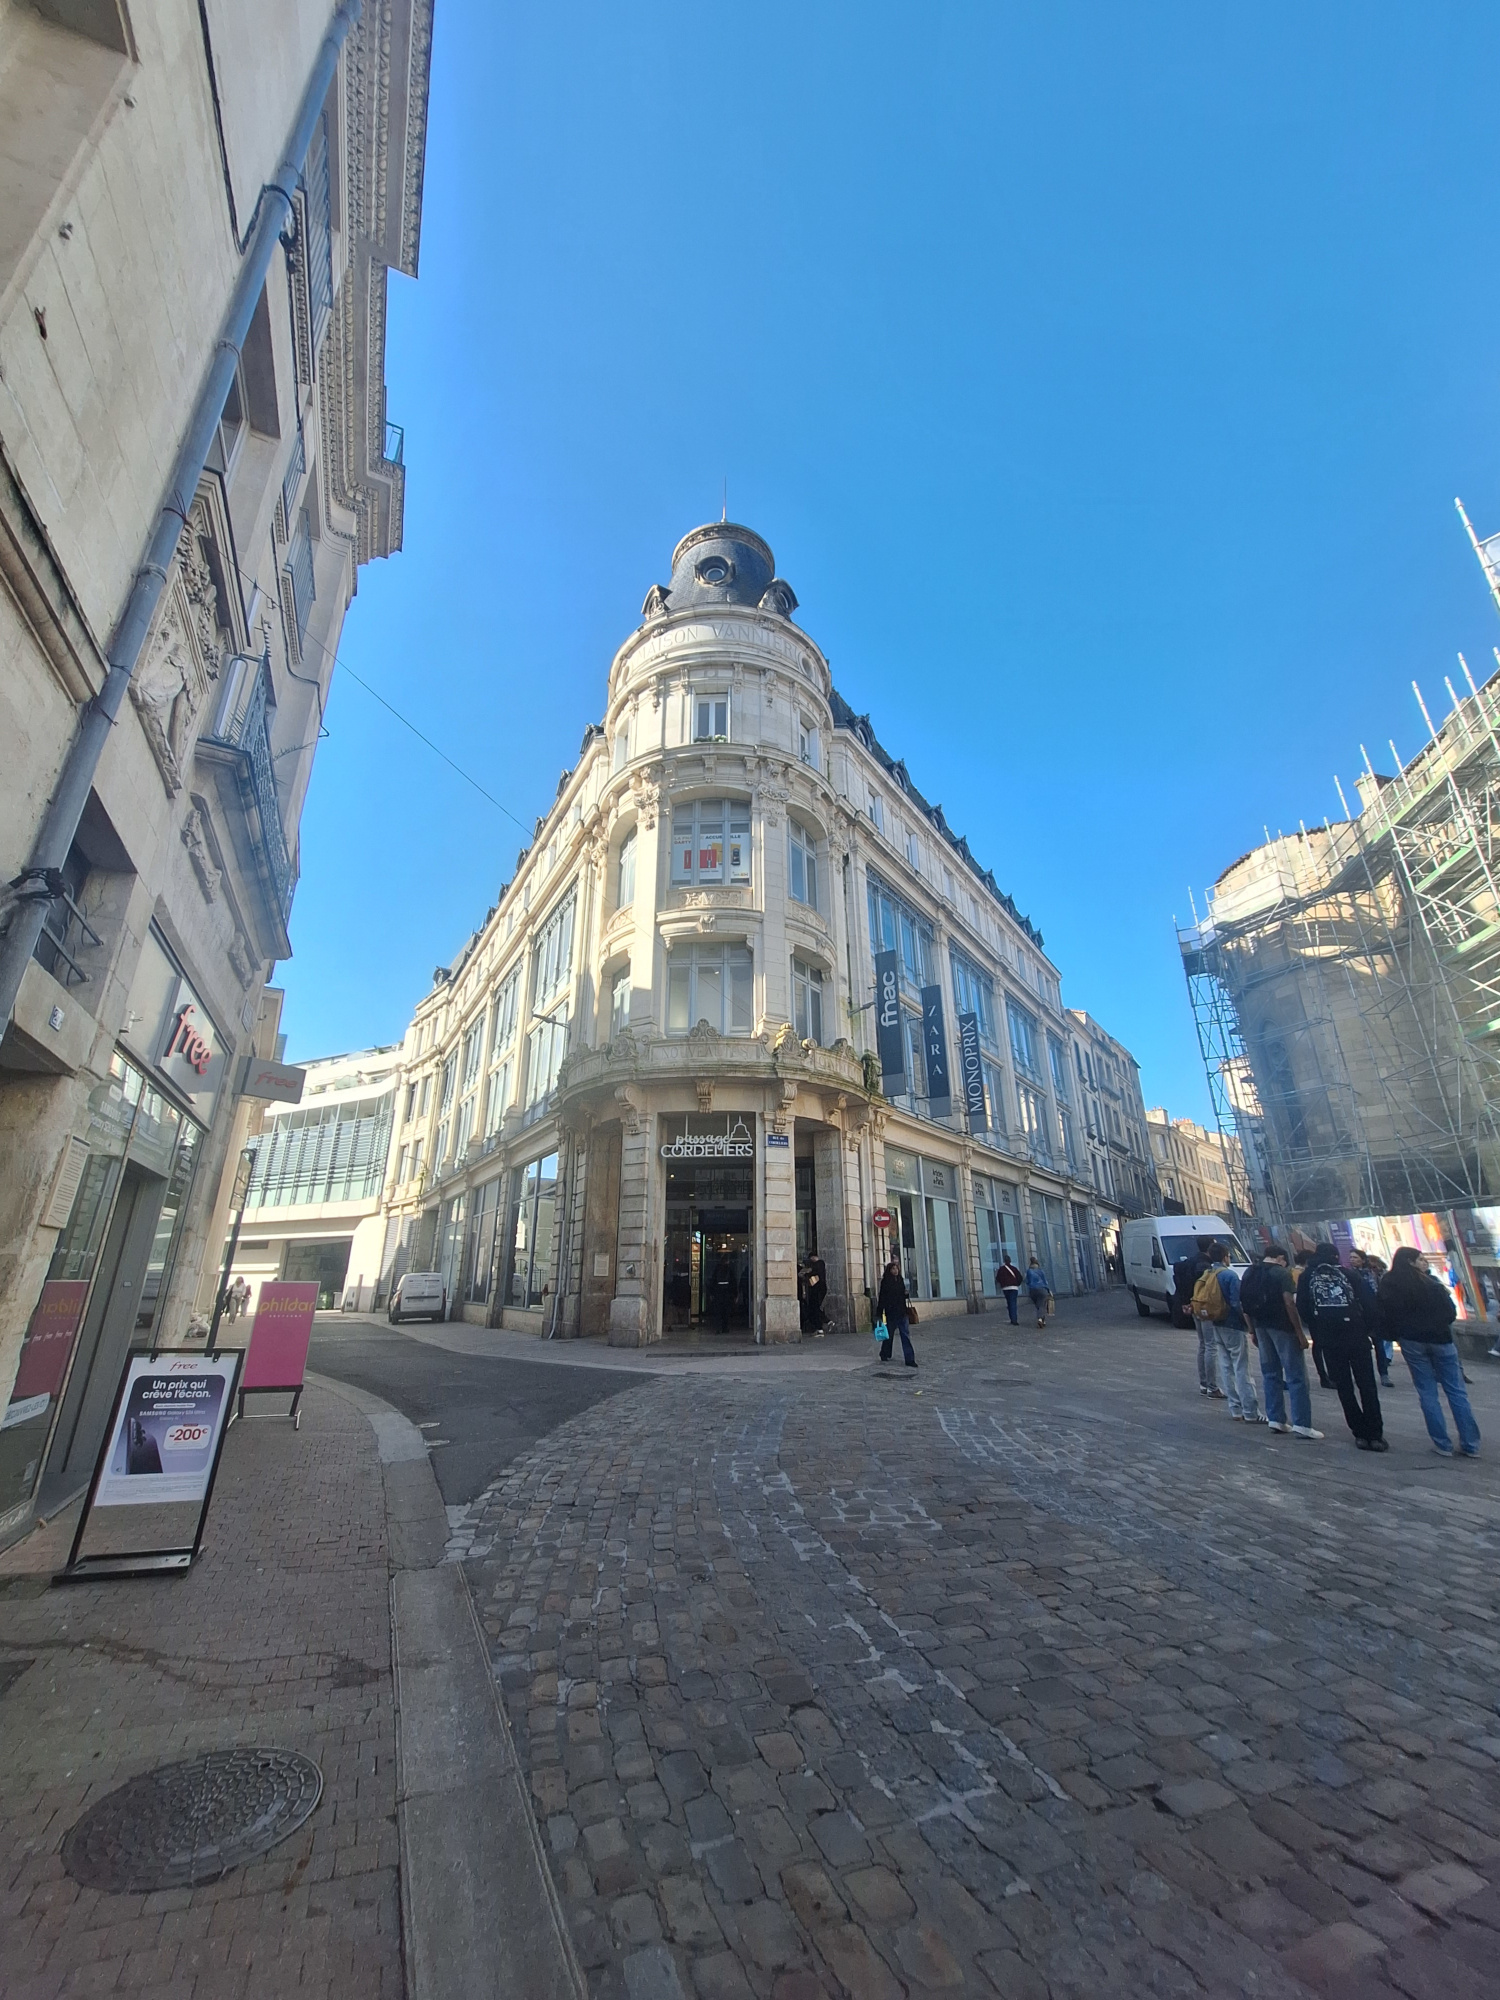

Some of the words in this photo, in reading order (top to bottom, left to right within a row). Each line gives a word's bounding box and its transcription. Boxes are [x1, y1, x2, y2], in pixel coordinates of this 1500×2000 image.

[636, 626, 698, 664] MAISON
[710, 623, 793, 658] VANNIER
[881, 970, 898, 1028] fnac
[165, 1004, 212, 1075] free
[928, 1005, 943, 1075] ZARA
[961, 1019, 984, 1113] MONOPRIX
[255, 1071, 299, 1088] free
[660, 1143, 753, 1158] CORDELIERS
[675, 1134, 732, 1150] passage
[259, 1297, 315, 1315] phildar
[169, 1361, 198, 1372] free
[152, 1380, 166, 1390] Un
[167, 1379, 189, 1391] prix
[189, 1379, 208, 1391] qui
[142, 1389, 172, 1399] crève
[173, 1389, 211, 1399] l'écran.
[168, 1428, 208, 1441] -200€
